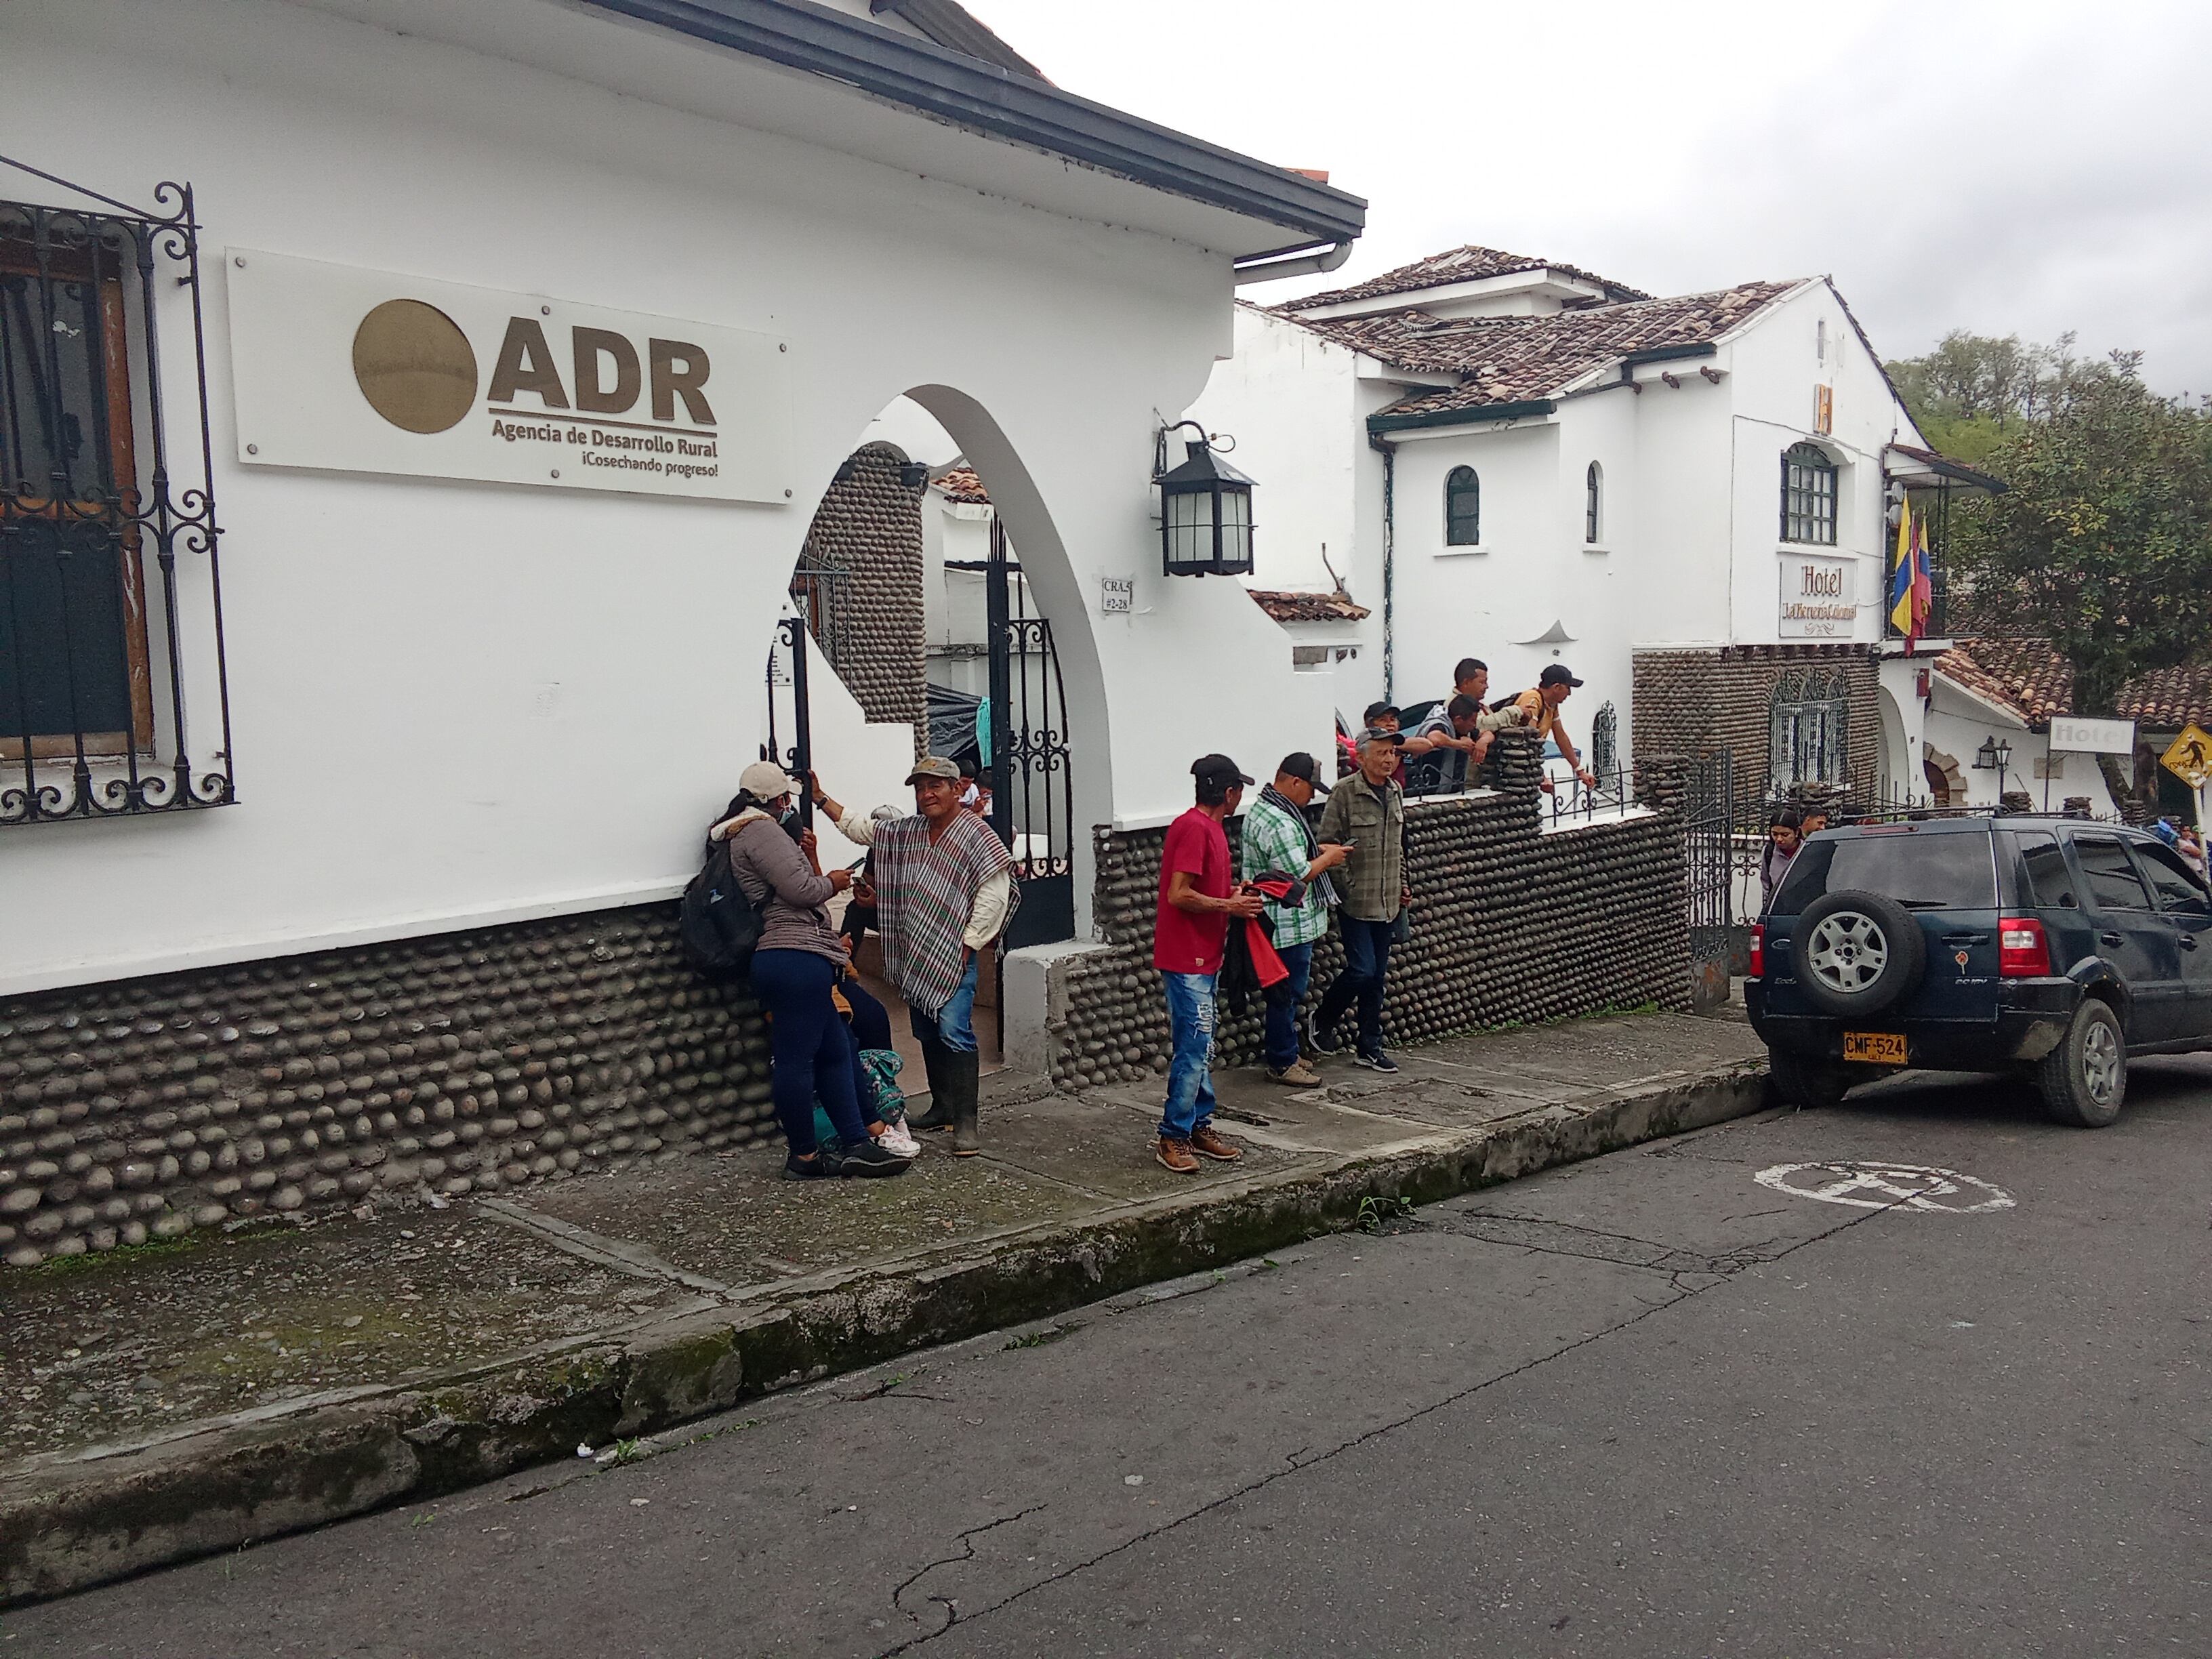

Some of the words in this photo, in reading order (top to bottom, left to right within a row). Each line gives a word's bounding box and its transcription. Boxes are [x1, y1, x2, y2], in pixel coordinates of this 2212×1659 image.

[487, 316, 717, 425] ADR
[492, 419, 562, 442] Agencia
[567, 426, 587, 444] de
[592, 430, 674, 453] Desarrollo
[678, 438, 718, 458] Rural
[582, 451, 663, 472] ¡Cosechando
[665, 464, 718, 478] progreso!
[1804, 566, 1842, 595] Hotel
